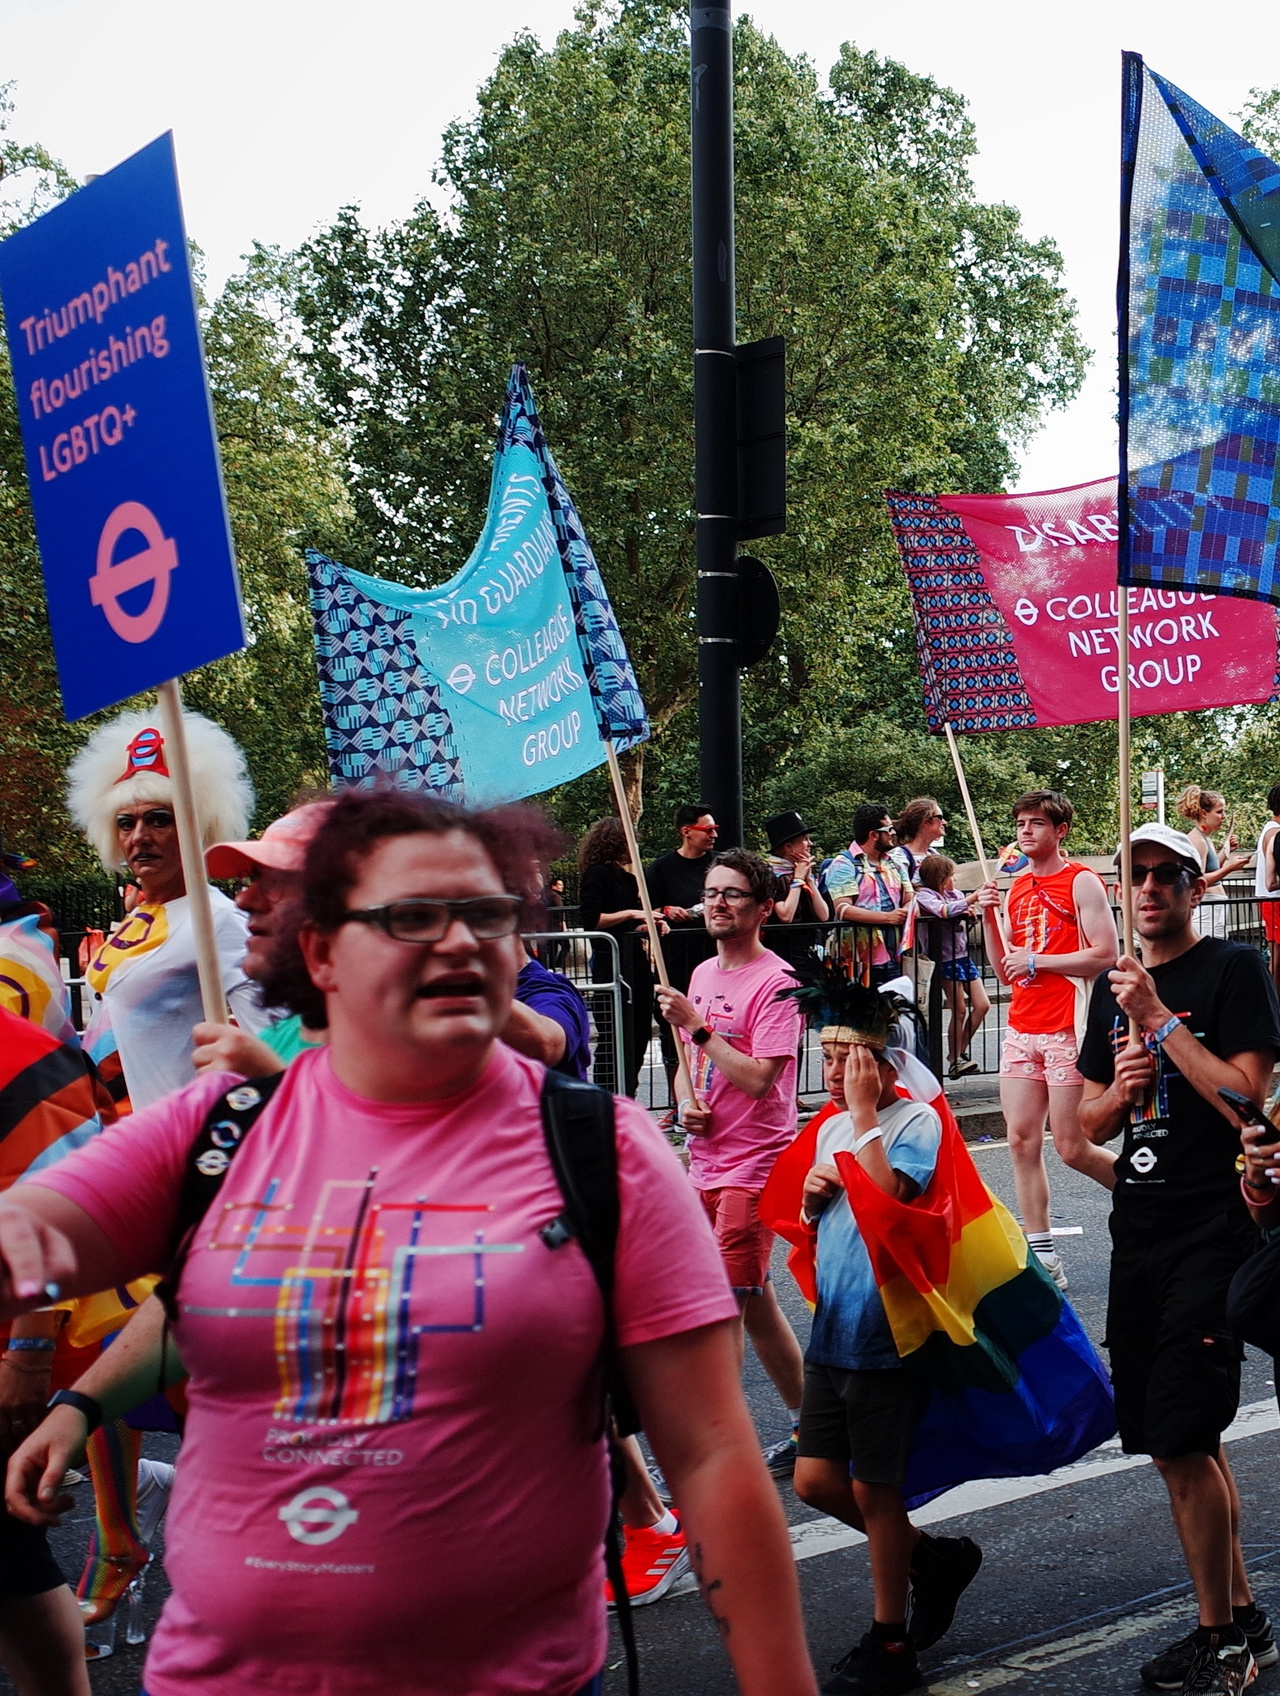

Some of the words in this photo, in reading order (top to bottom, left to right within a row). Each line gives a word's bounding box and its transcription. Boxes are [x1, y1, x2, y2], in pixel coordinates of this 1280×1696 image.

[20, 238, 171, 355] Triumphant
[30, 314, 170, 420] flourishing
[39, 404, 137, 482] LGBTQ+
[485, 603, 571, 686] COLLEAGUE
[1068, 611, 1220, 657] NETWORK
[499, 655, 584, 726] NETWORK
[1101, 654, 1201, 693] GROUP
[522, 709, 582, 767] GROUP
[262, 1447, 404, 1467] CONNECTED
